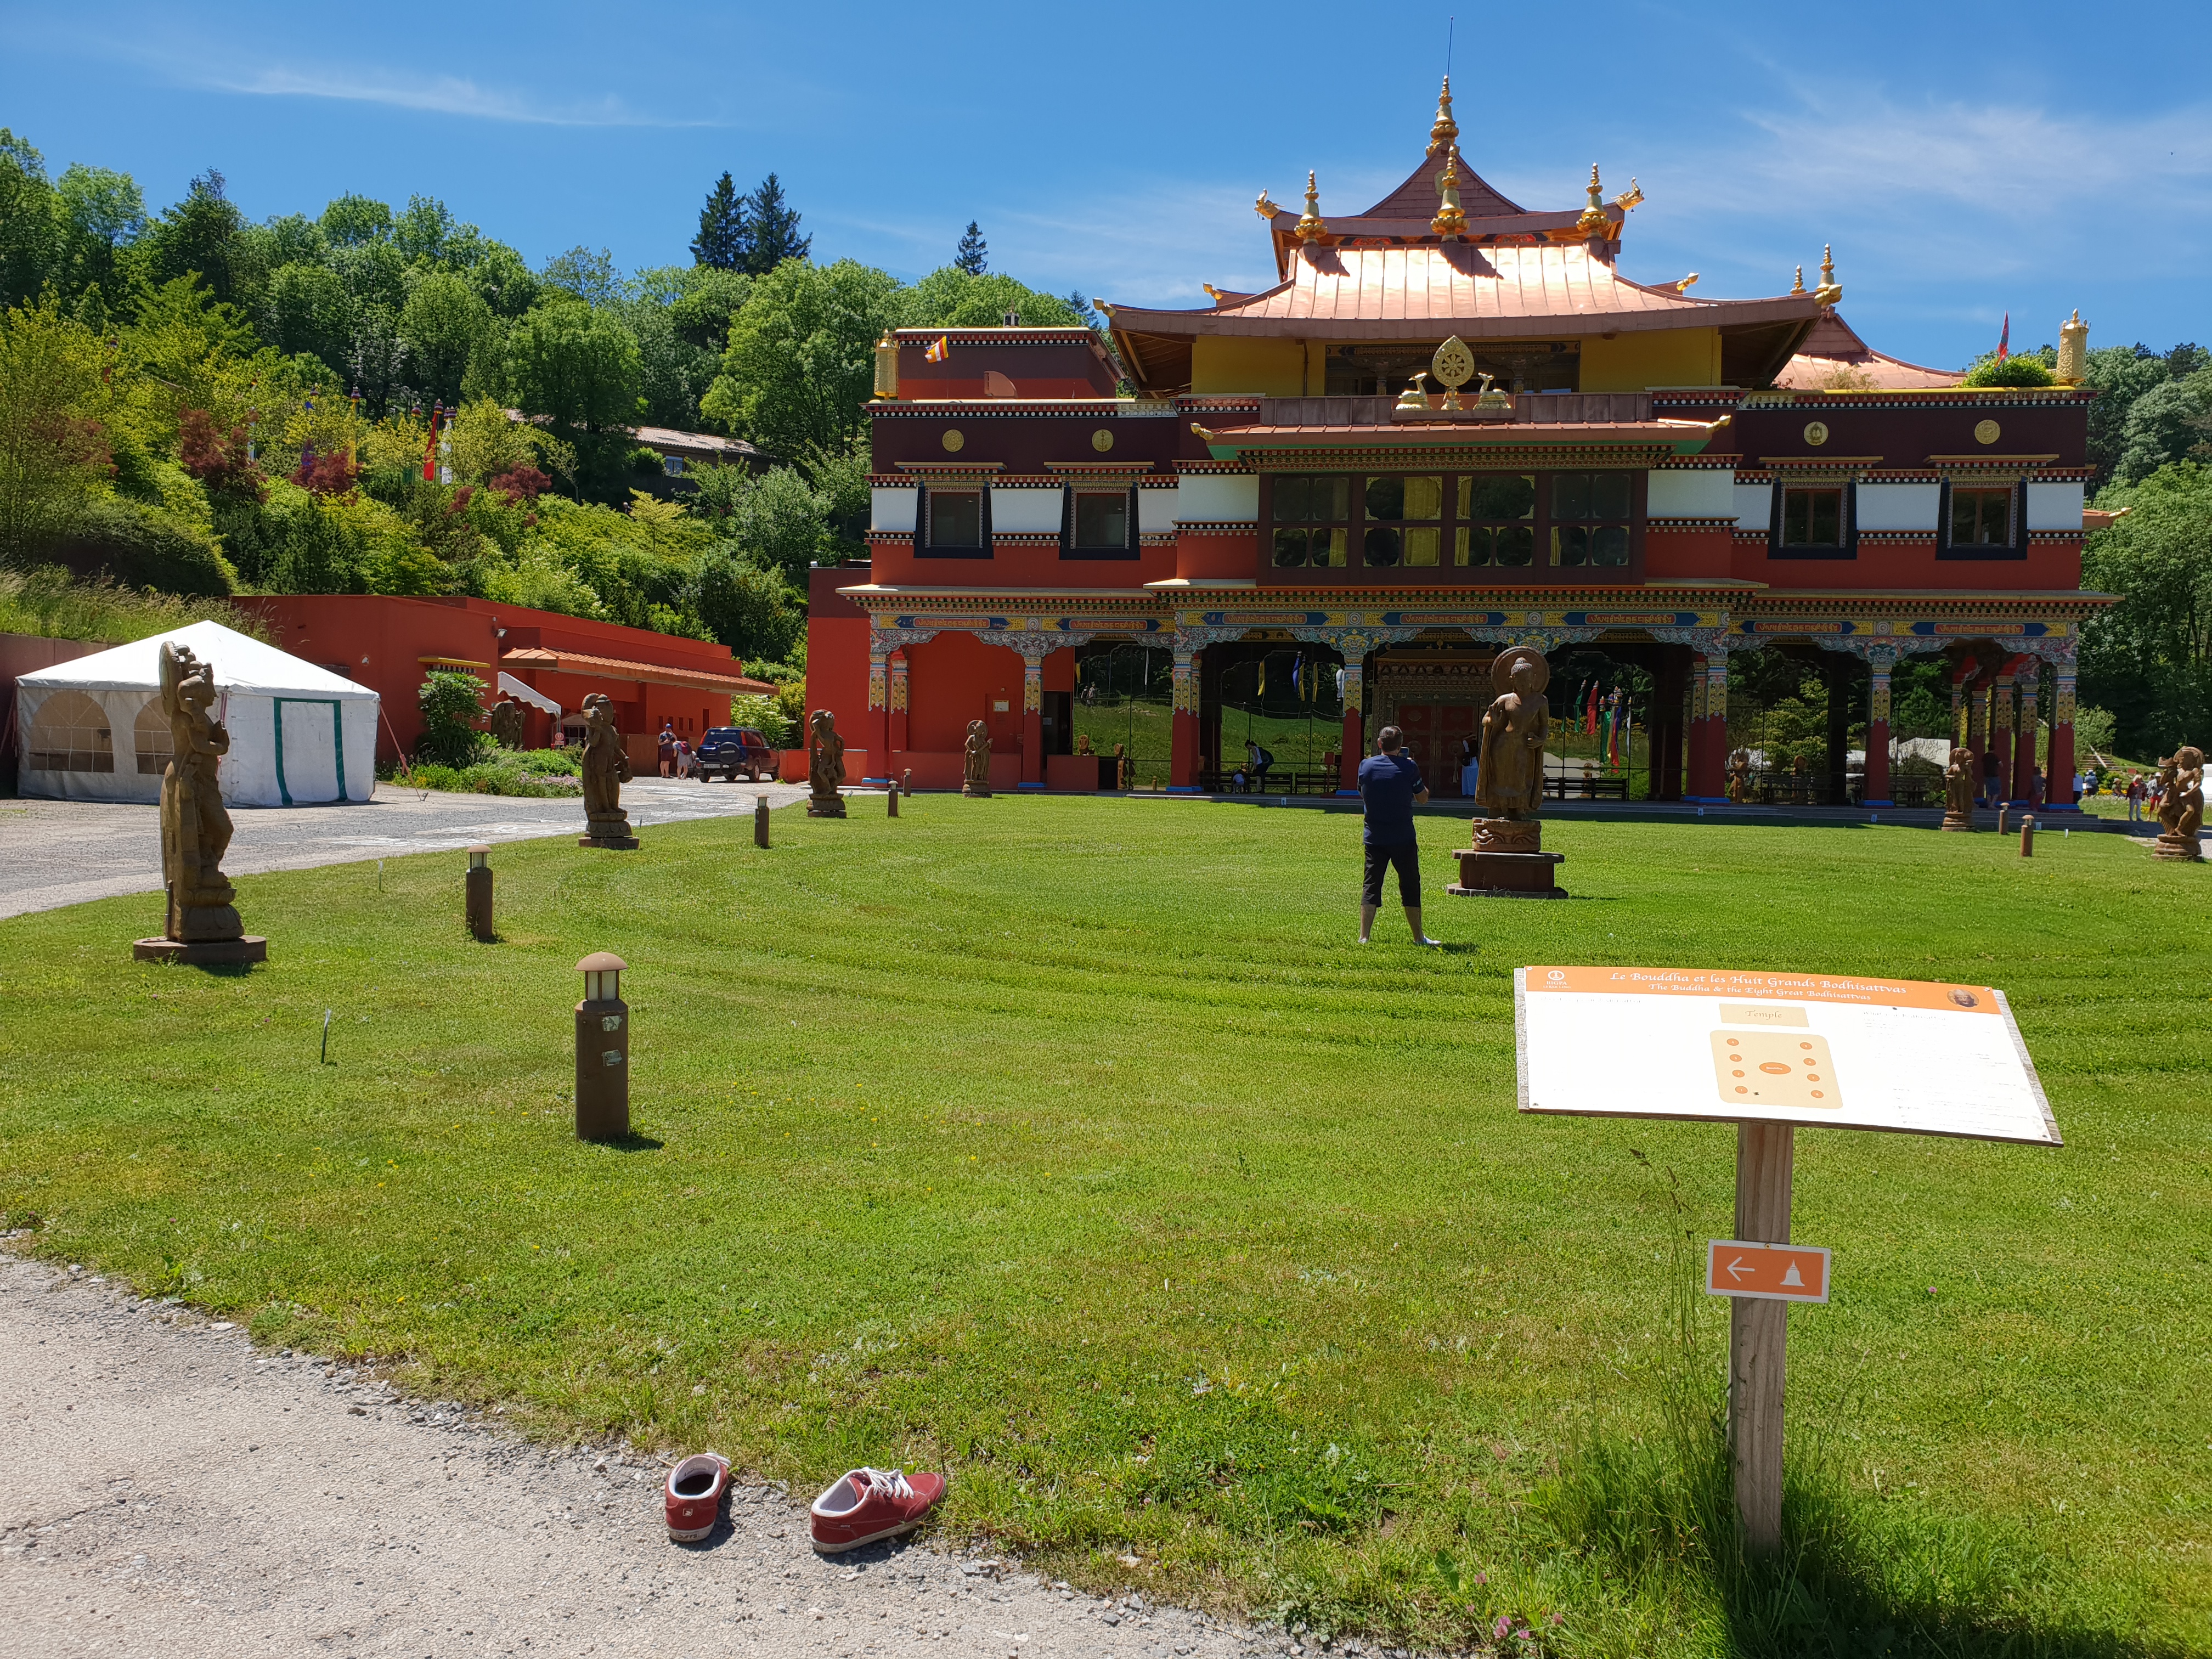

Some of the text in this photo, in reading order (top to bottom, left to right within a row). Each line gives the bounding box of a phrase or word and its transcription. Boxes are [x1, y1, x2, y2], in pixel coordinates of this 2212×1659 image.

[1610, 972, 1626, 980] Le
[1630, 972, 1690, 981] Bouddha
[1710, 974, 1726, 983] les
[1730, 974, 1763, 984] Huit
[1767, 978, 1815, 988] Grands
[1819, 980, 1906, 994] Bodhisattvas
[1671, 984, 1710, 992] Buddha
[1745, 987, 1774, 996] Eight
[1807, 990, 1871, 1001] Bodhisattvas
[1745, 1009, 1782, 1020] Temple
